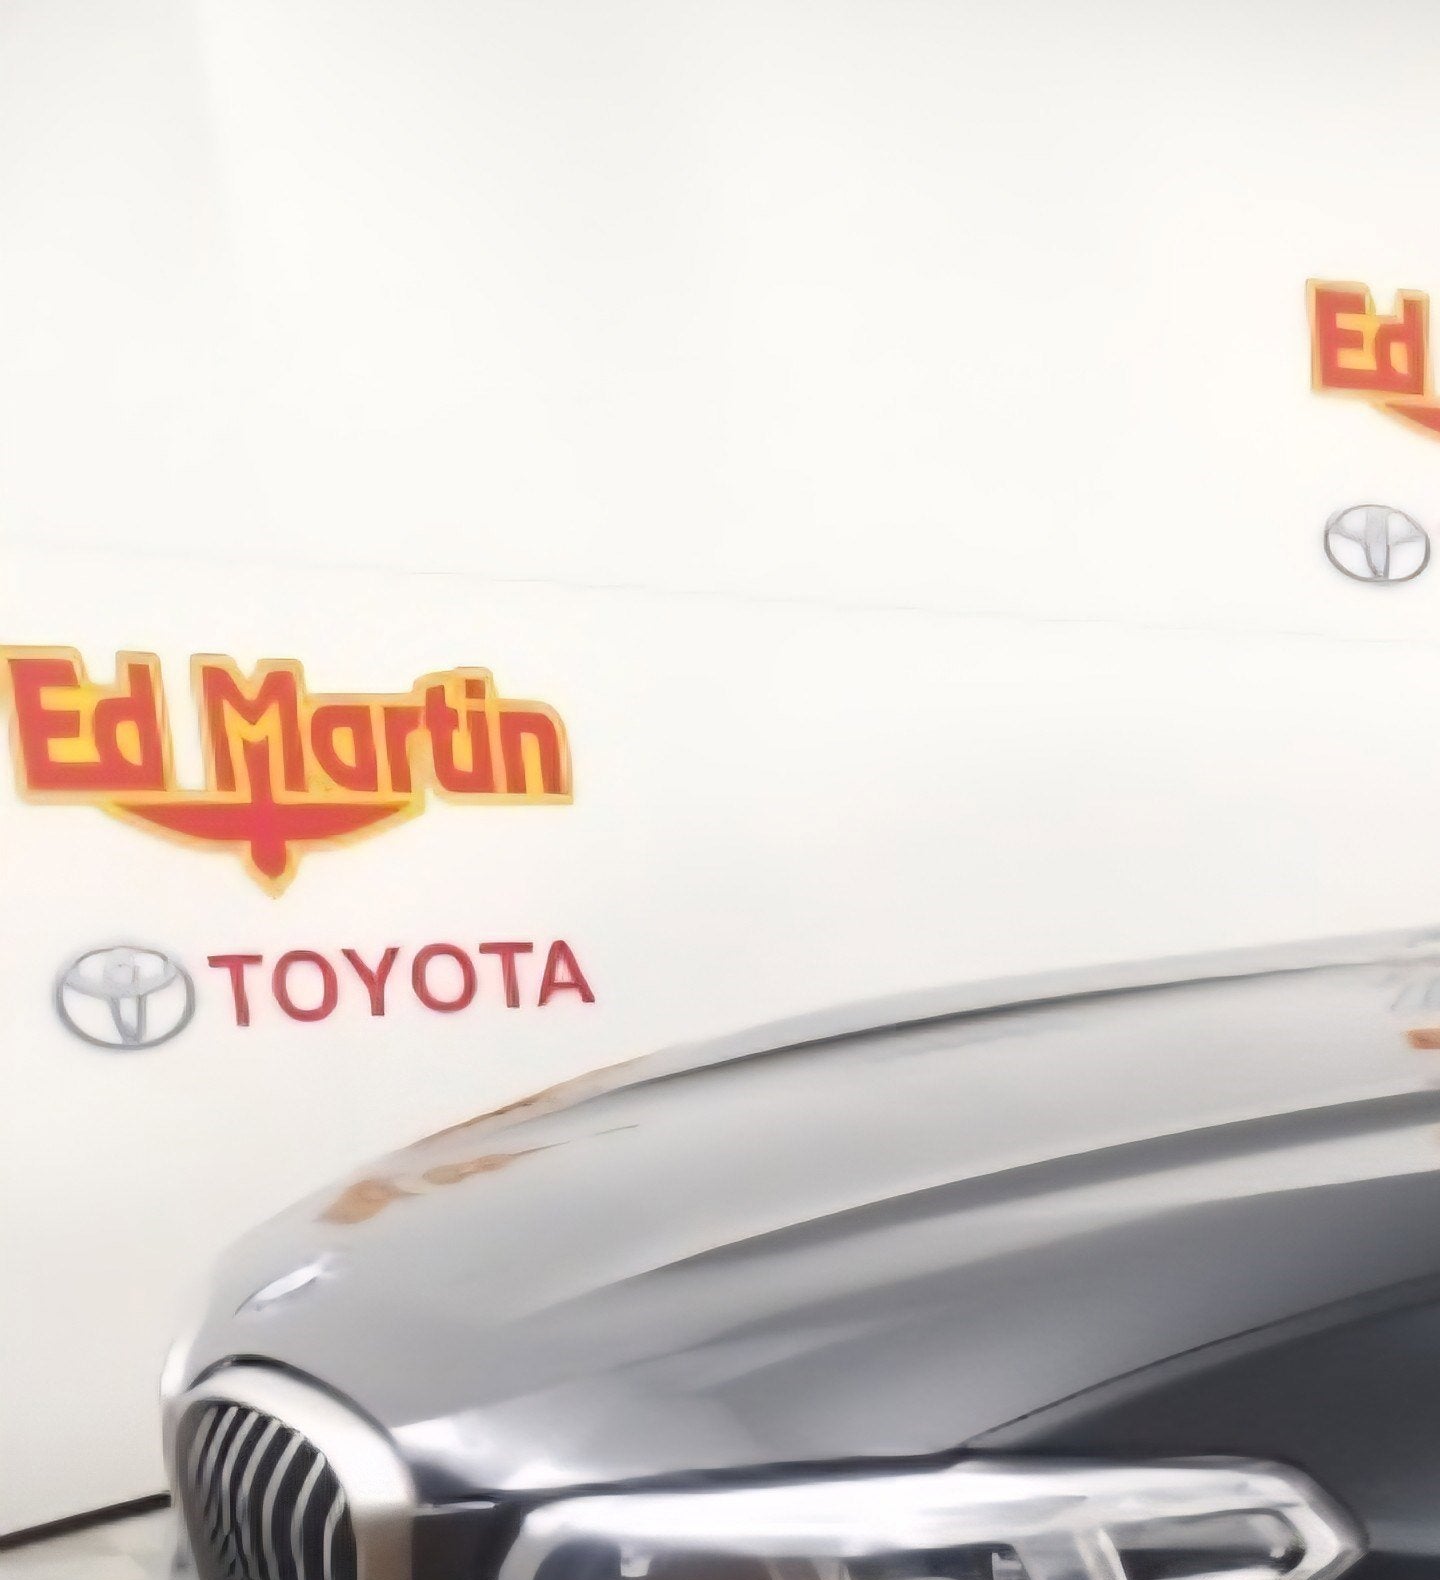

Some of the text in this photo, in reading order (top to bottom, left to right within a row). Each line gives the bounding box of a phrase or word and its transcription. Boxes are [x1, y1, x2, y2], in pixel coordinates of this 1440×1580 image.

[1308, 281, 1428, 397] Ed
[4, 650, 570, 798] Ed Martin
[207, 939, 596, 1027] TOYOTA
